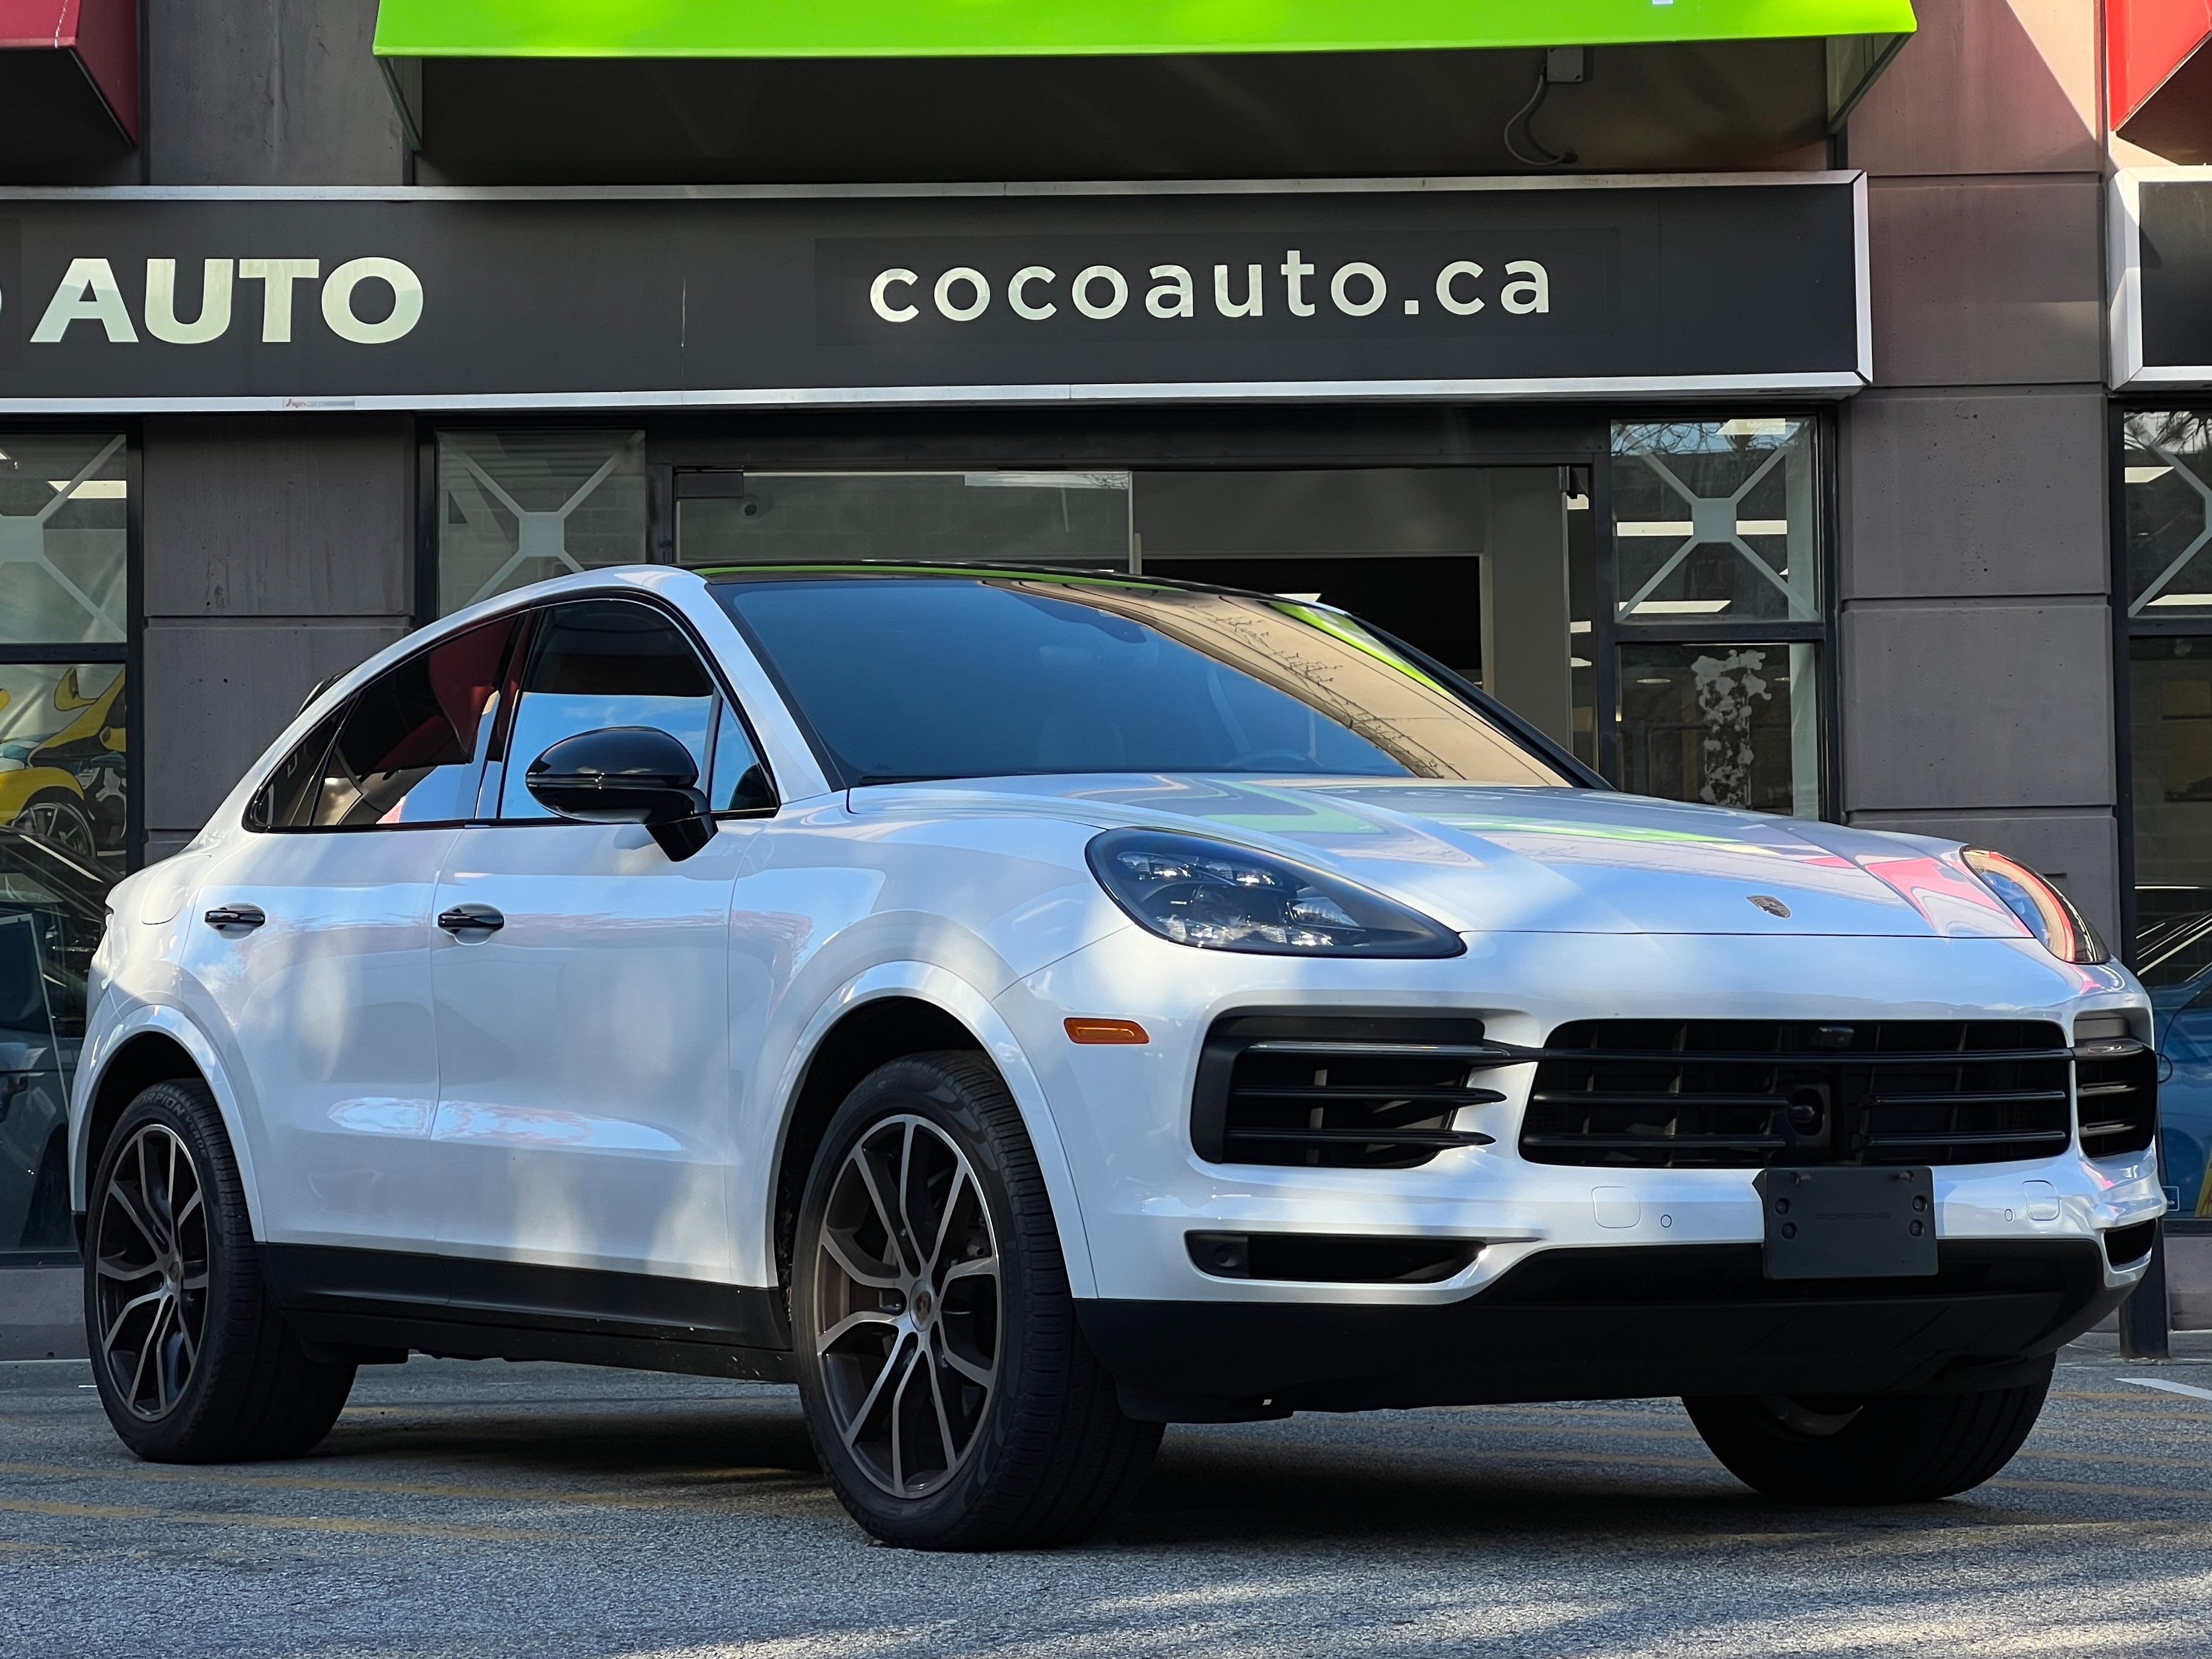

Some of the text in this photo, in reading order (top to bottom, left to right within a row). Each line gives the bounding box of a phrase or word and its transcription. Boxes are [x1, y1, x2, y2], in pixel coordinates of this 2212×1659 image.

[30, 257, 423, 344] AUTO
[870, 250, 1549, 323] cocoauto.ca
[130, 1092, 209, 1158] ORPION VERDE
